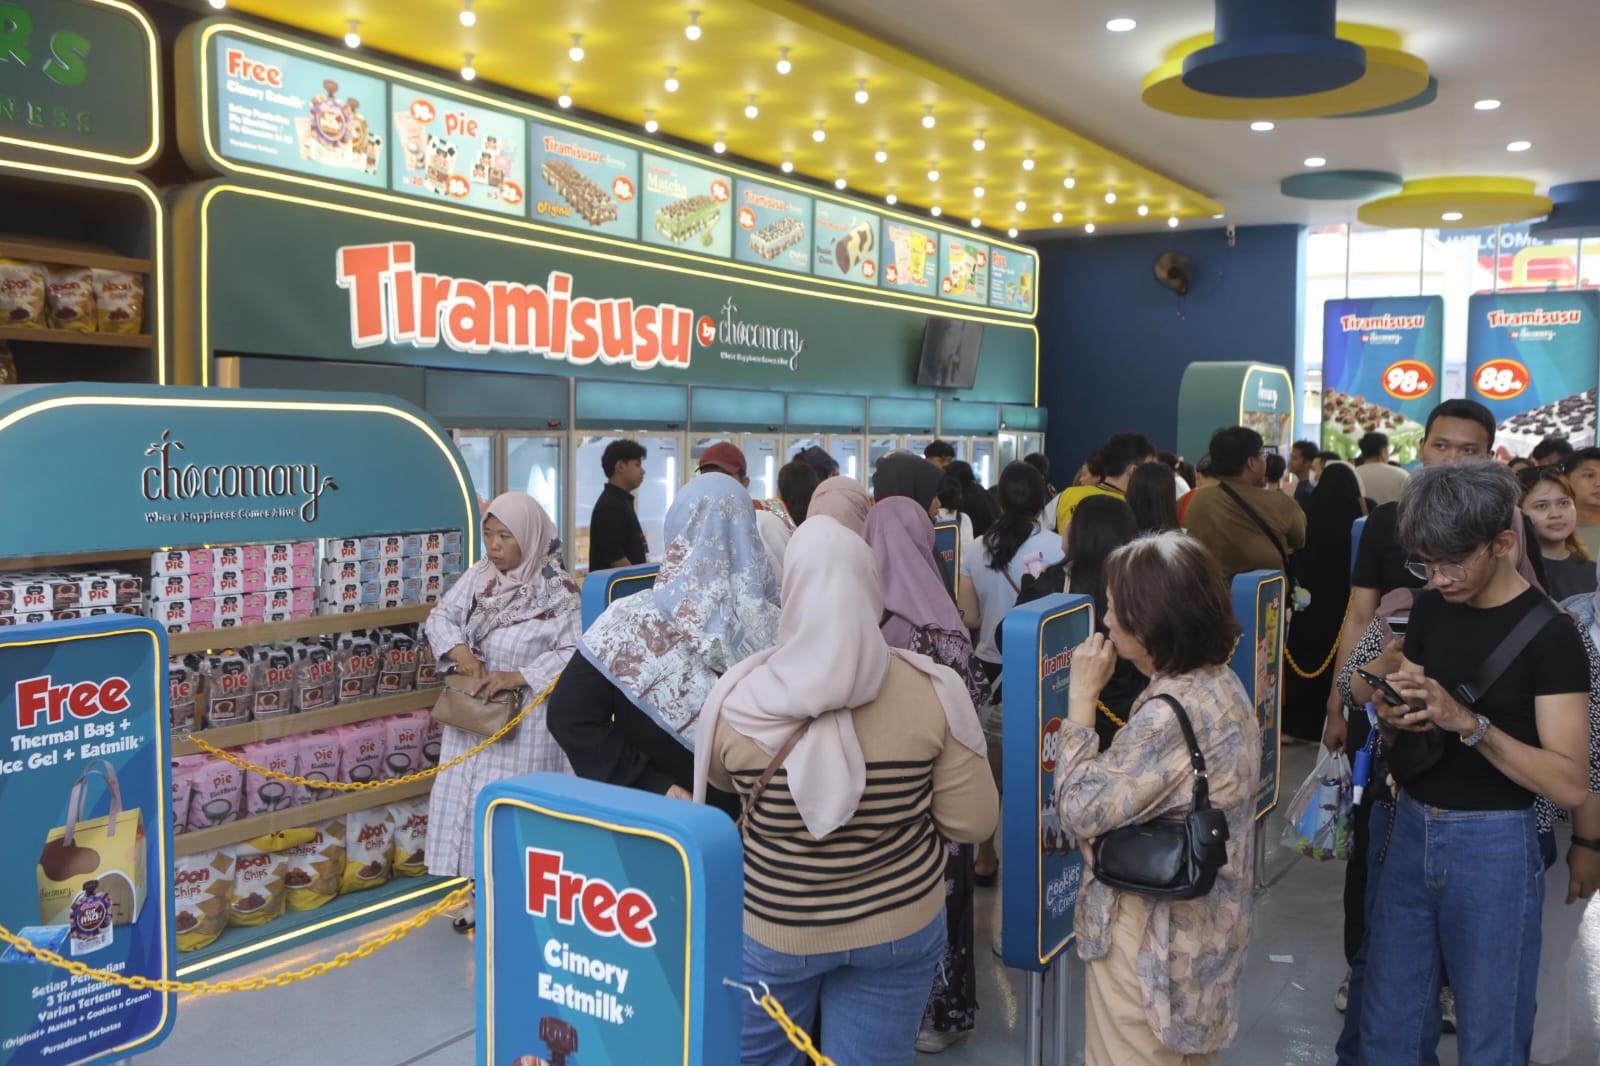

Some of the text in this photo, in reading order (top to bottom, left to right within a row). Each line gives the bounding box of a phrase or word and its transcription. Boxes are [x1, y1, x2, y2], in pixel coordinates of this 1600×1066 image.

[226, 48, 282, 87] Free
[444, 111, 478, 138] pie
[543, 136, 599, 164] Tiramisusu
[337, 241, 694, 369] Tiramisusu
[702, 321, 716, 341] by
[1340, 313, 1425, 332] Tiramisusu
[1487, 307, 1581, 328] Tiramisusu
[142, 431, 337, 523] chocomory
[145, 506, 297, 523] Where Happiness Comes Alive
[341, 546, 357, 558] pie
[385, 543, 400, 554] pie
[426, 540, 440, 550] pie
[165, 558, 185, 571] pie
[220, 555, 239, 567] pie
[271, 551, 288, 563] pie
[341, 568, 357, 580] pie
[384, 564, 399, 576] pie
[425, 561, 440, 572] pie
[220, 578, 239, 590] pie
[271, 573, 288, 585] pie
[426, 581, 440, 591] pie
[88, 588, 110, 602] pie
[165, 583, 185, 596] pie
[342, 590, 358, 602] pie
[385, 586, 400, 597] pie
[23, 592, 46, 607] pie
[271, 597, 289, 609] pie
[166, 608, 186, 621] pie
[220, 603, 239, 615] pie
[350, 652, 376, 673] pie
[390, 647, 415, 666] pie
[1042, 646, 1074, 680] Tiramis
[266, 665, 293, 687] pie
[310, 658, 332, 681] pie
[221, 670, 249, 693] pie
[170, 681, 191, 700] ie
[15, 675, 131, 730] Free
[11, 725, 79, 752] Thermal
[83, 721, 115, 738] Bag
[399, 731, 416, 744] pie
[313, 748, 333, 761] pie
[360, 742, 376, 755] pie
[28, 750, 58, 770] Gel
[269, 758, 288, 771] pie
[213, 773, 233, 789] pie
[175, 867, 210, 885] bon
[526, 846, 658, 948] Free
[544, 938, 629, 994] Cimory
[31, 980, 68, 999] Setiap
[38, 988, 122, 1023] Varian Tertentu
[46, 996, 55, 1007] 3
[48, 1019, 77, 1034] Matcha
[87, 1006, 118, 1020] Cookies
[89, 1022, 122, 1038] Terbatas
